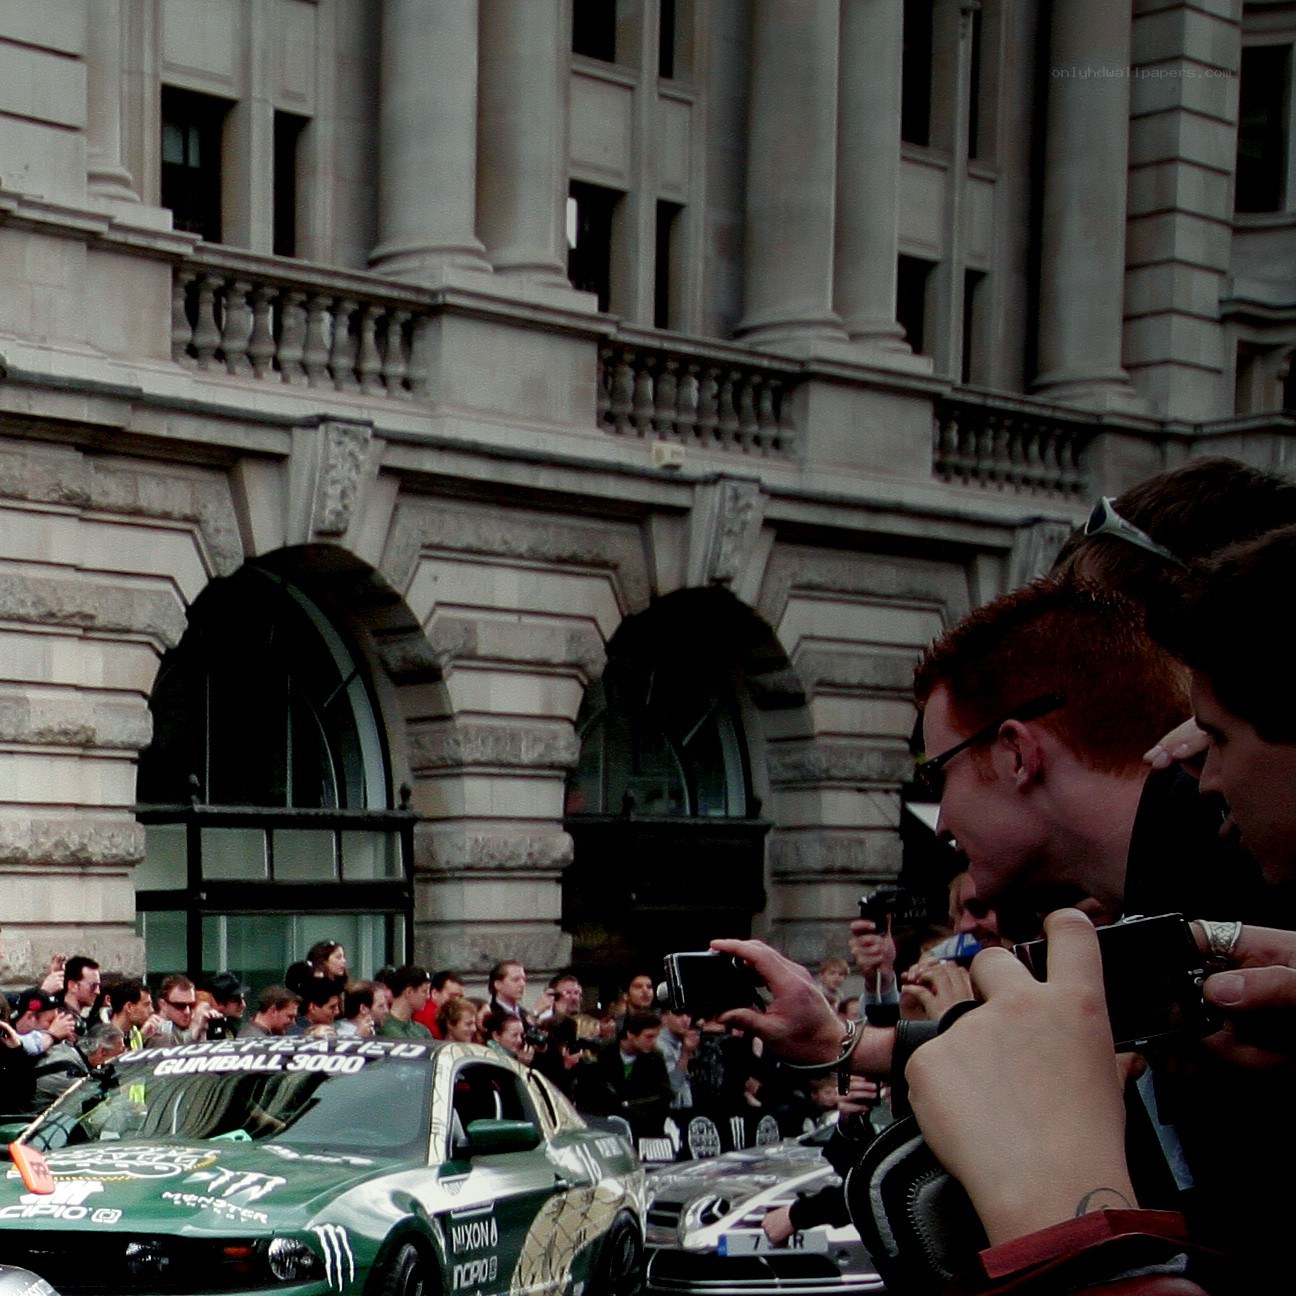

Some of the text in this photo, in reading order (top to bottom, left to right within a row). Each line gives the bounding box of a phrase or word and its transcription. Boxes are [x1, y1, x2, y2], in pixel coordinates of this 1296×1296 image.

[153, 1053, 365, 1077] GUMBALL 3000
[452, 1220, 489, 1253] NIXON
